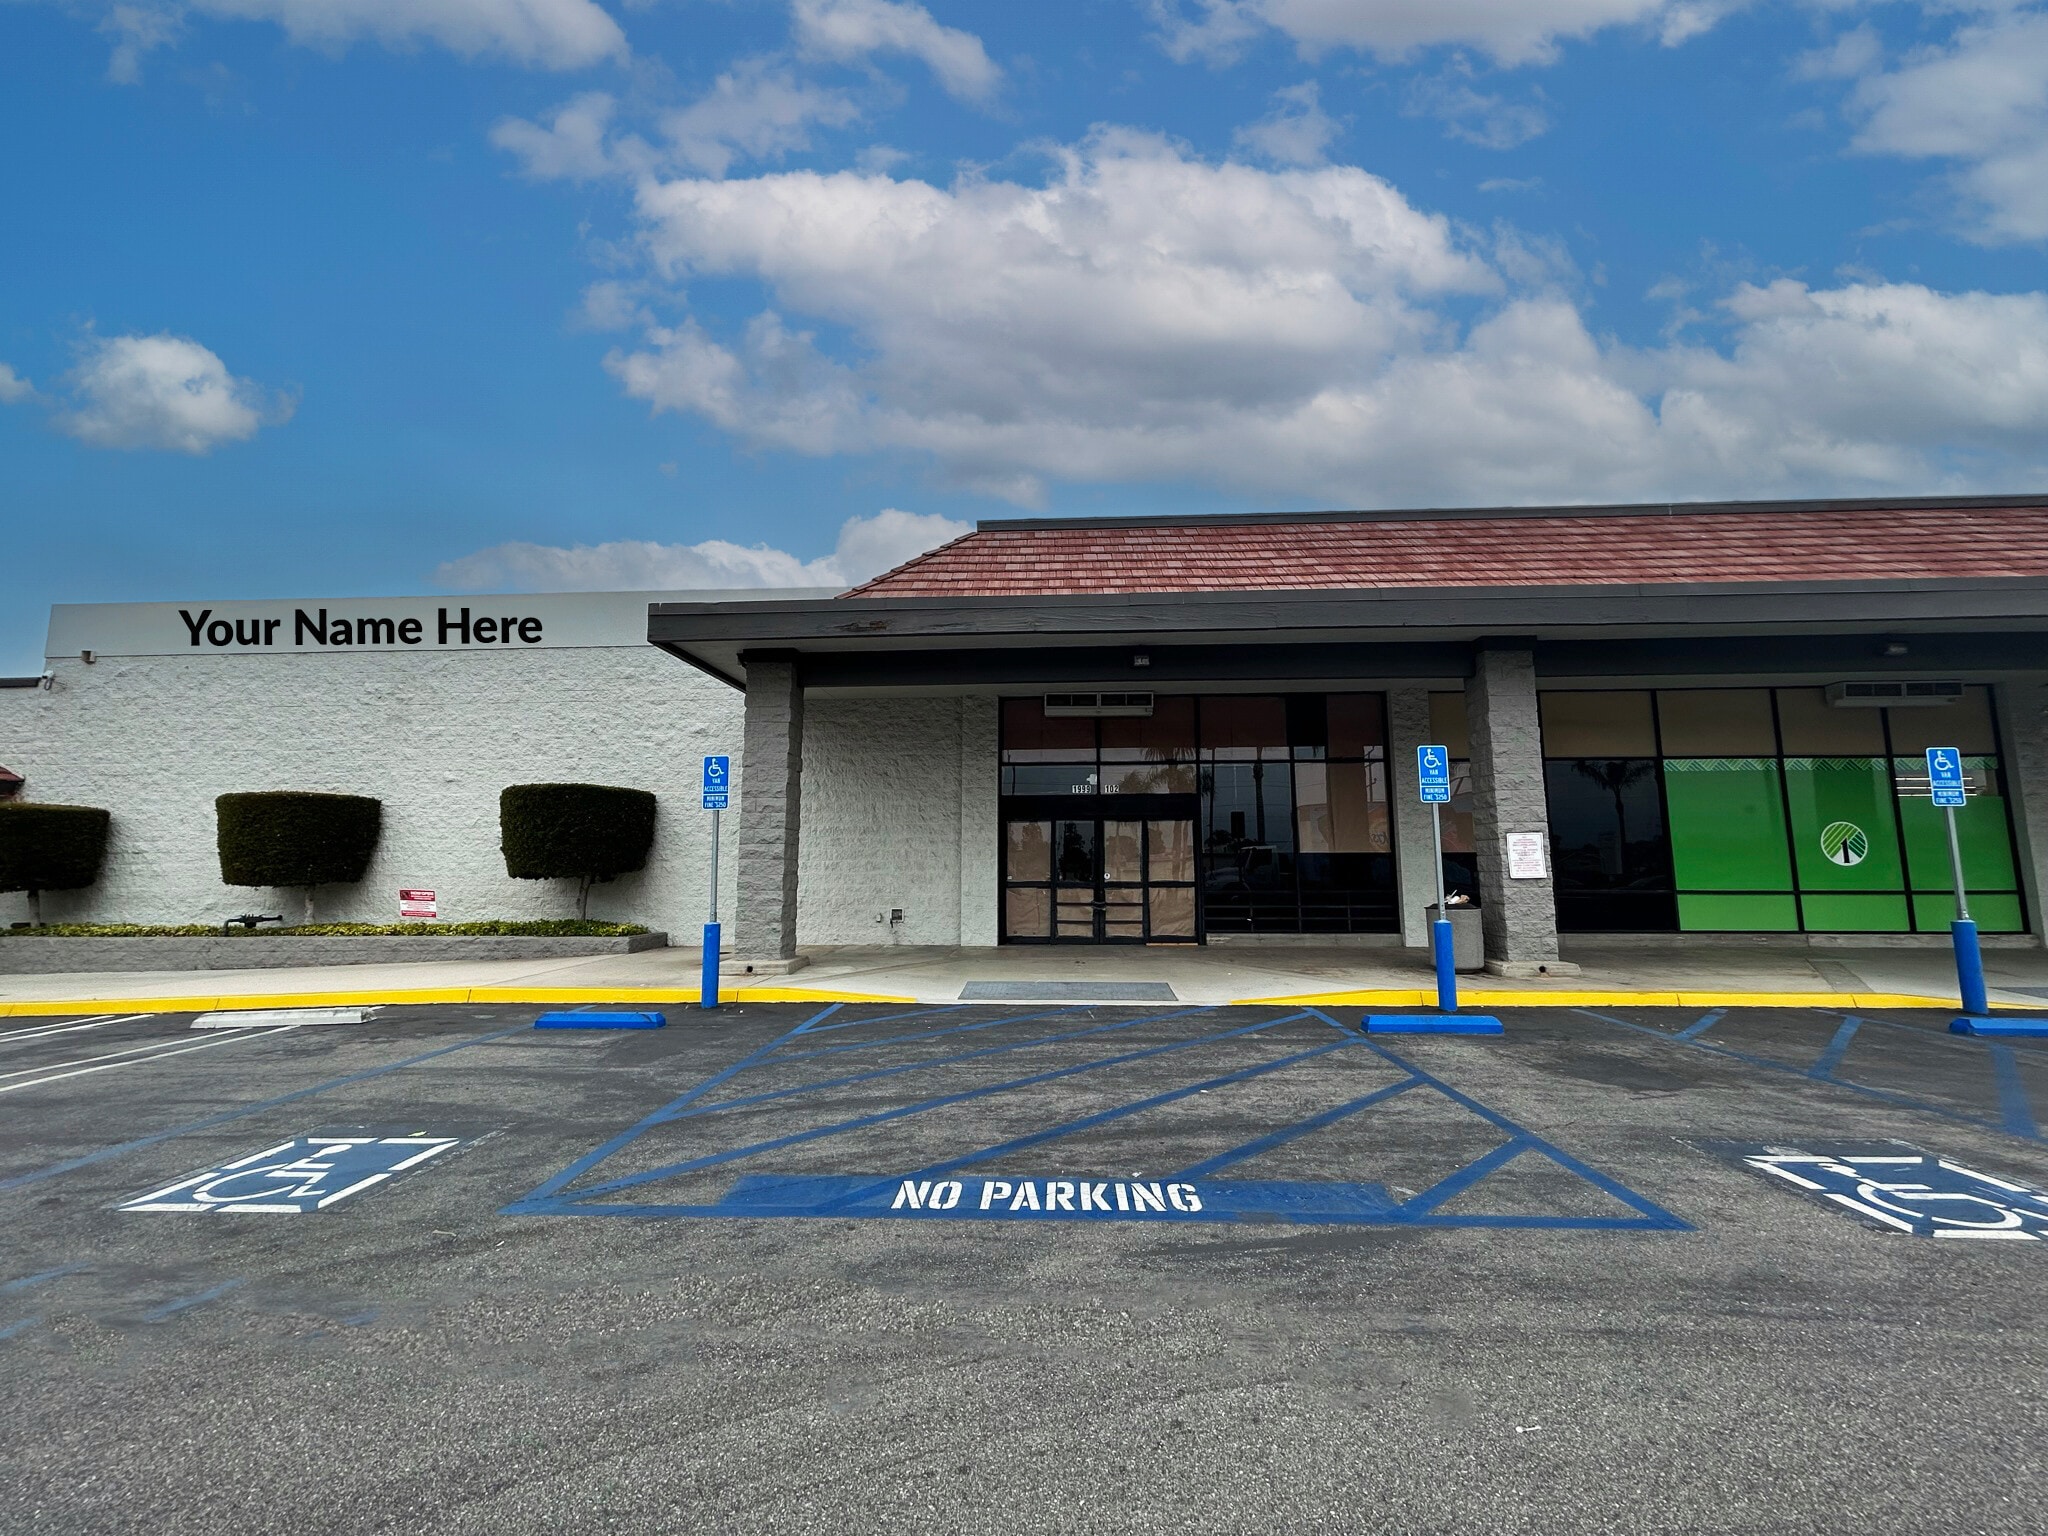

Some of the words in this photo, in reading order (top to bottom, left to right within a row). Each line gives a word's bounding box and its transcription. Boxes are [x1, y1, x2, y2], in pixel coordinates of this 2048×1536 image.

[178, 609, 281, 647] Your
[295, 608, 423, 646] Name
[437, 607, 543, 645] Here
[1072, 785, 1091, 793] 1999
[1104, 785, 1119, 793] 102
[890, 1180, 963, 1210] NO
[979, 1181, 1204, 1213] PARKING
